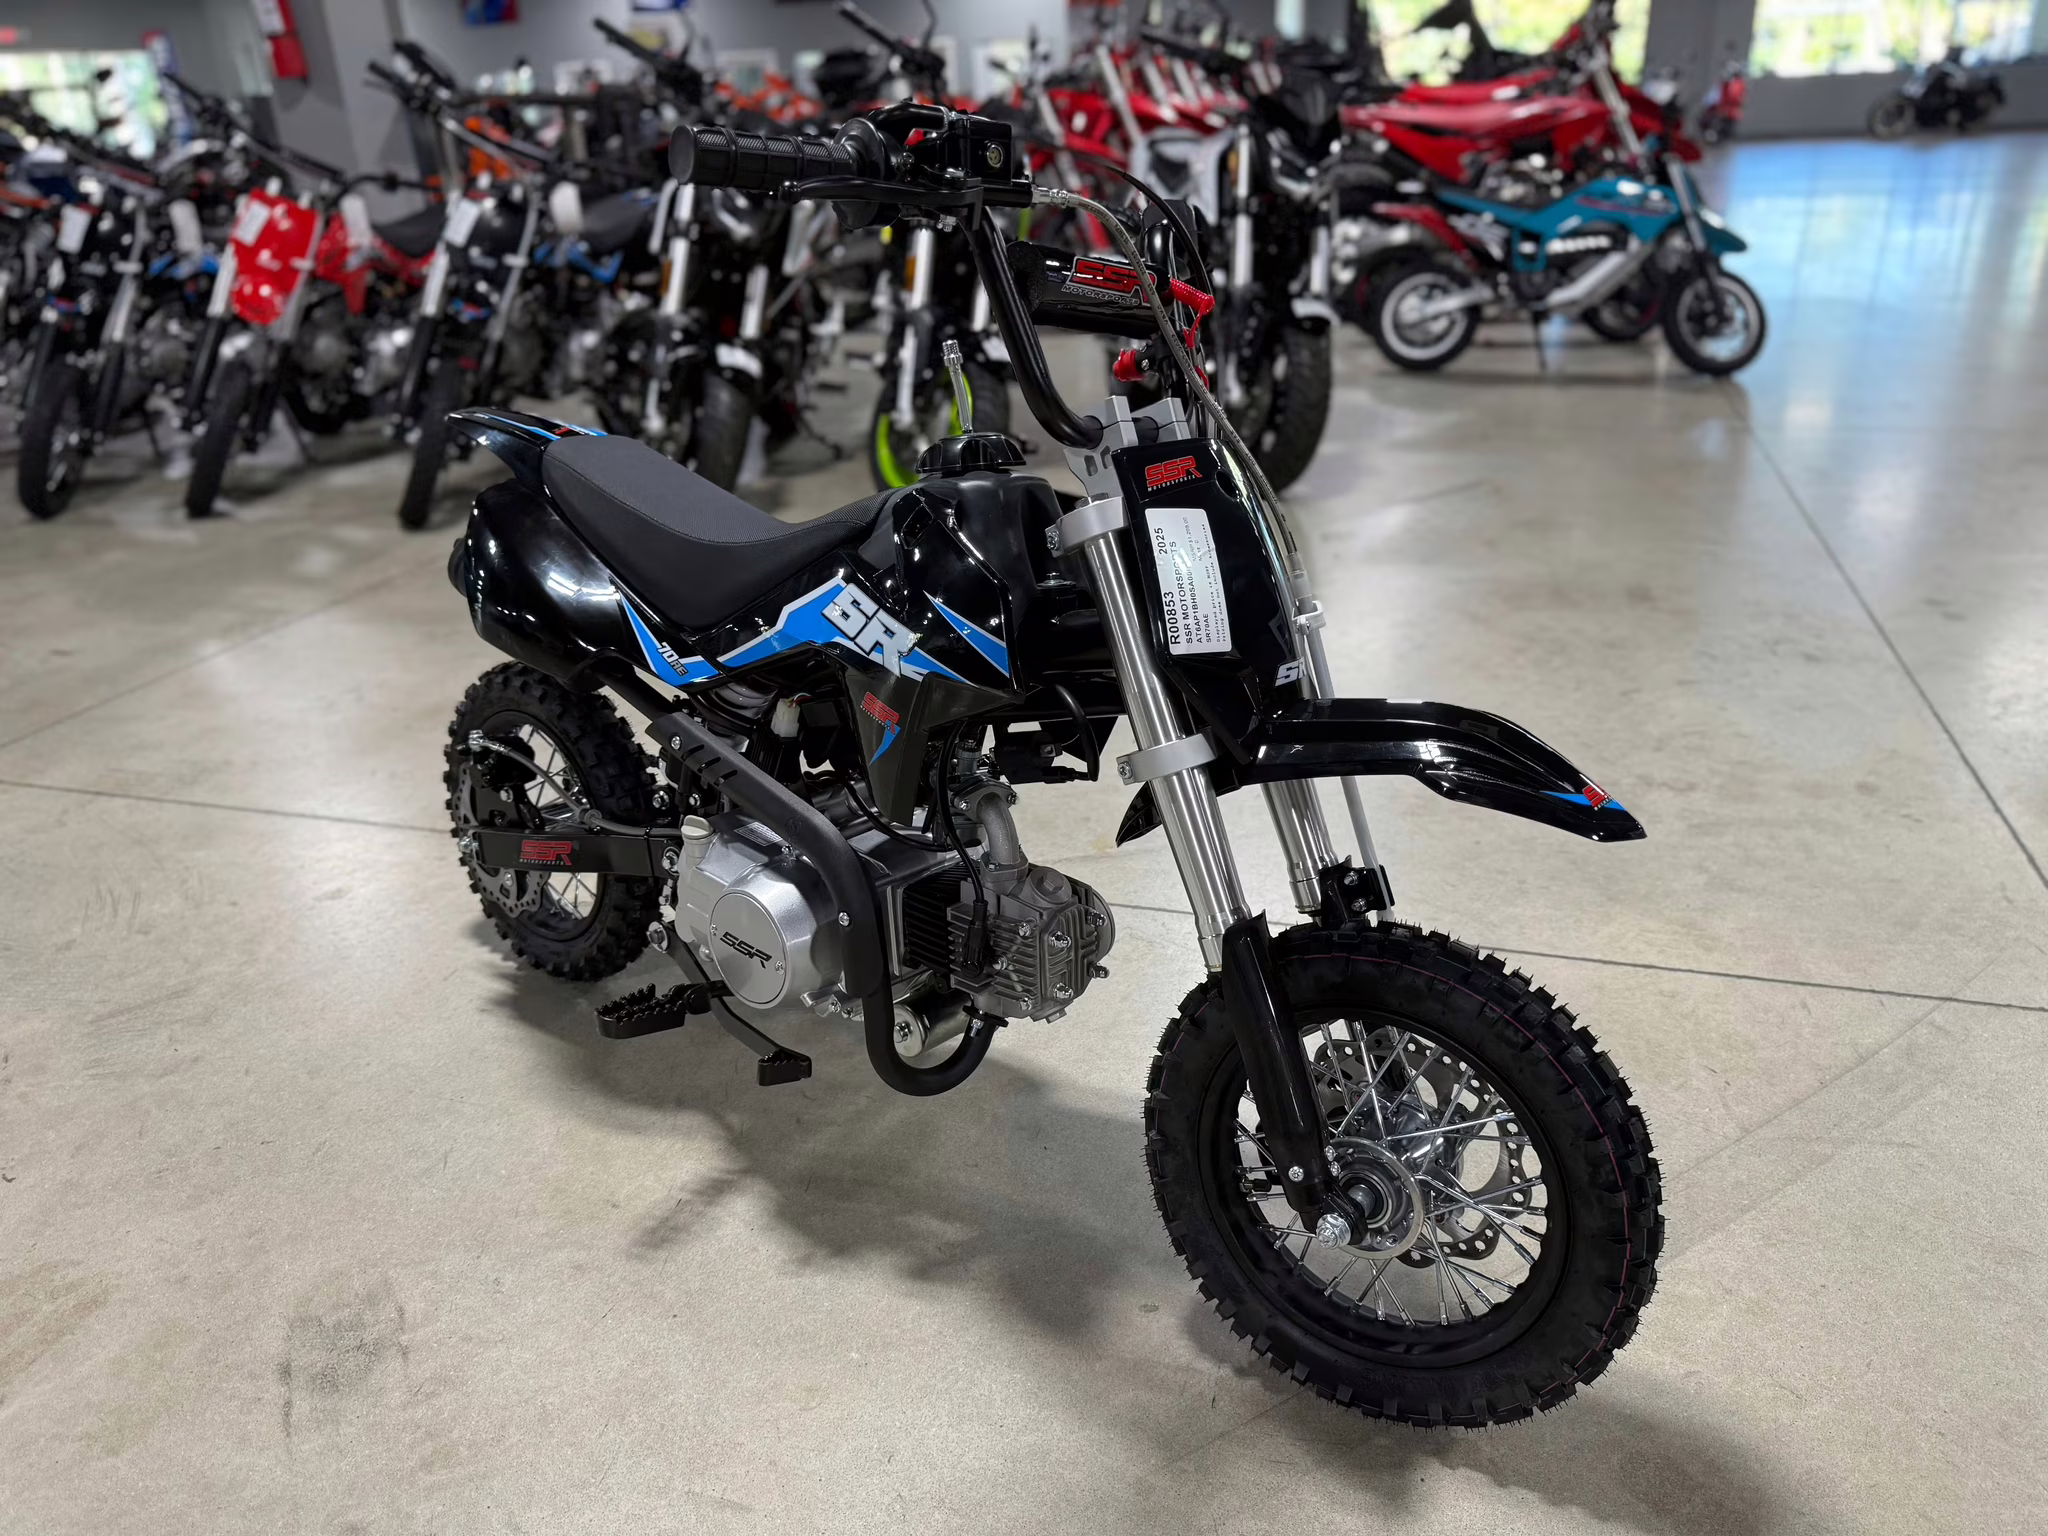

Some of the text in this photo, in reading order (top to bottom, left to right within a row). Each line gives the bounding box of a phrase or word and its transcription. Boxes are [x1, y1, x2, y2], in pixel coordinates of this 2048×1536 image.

[1061, 284, 1139, 306] MOTORSPORTS
[1070, 257, 1157, 305] SSR
[1145, 455, 1203, 487] SSR
[1147, 474, 1196, 492] MOTORSPORTS
[1154, 527, 1181, 645] R00853 2025
[822, 583, 916, 678] SR
[1182, 622, 1193, 644] SSR
[1203, 613, 1212, 643] SR70AE
[862, 691, 900, 735] SSR
[520, 840, 572, 865] SSR
[720, 931, 772, 969] SSR
